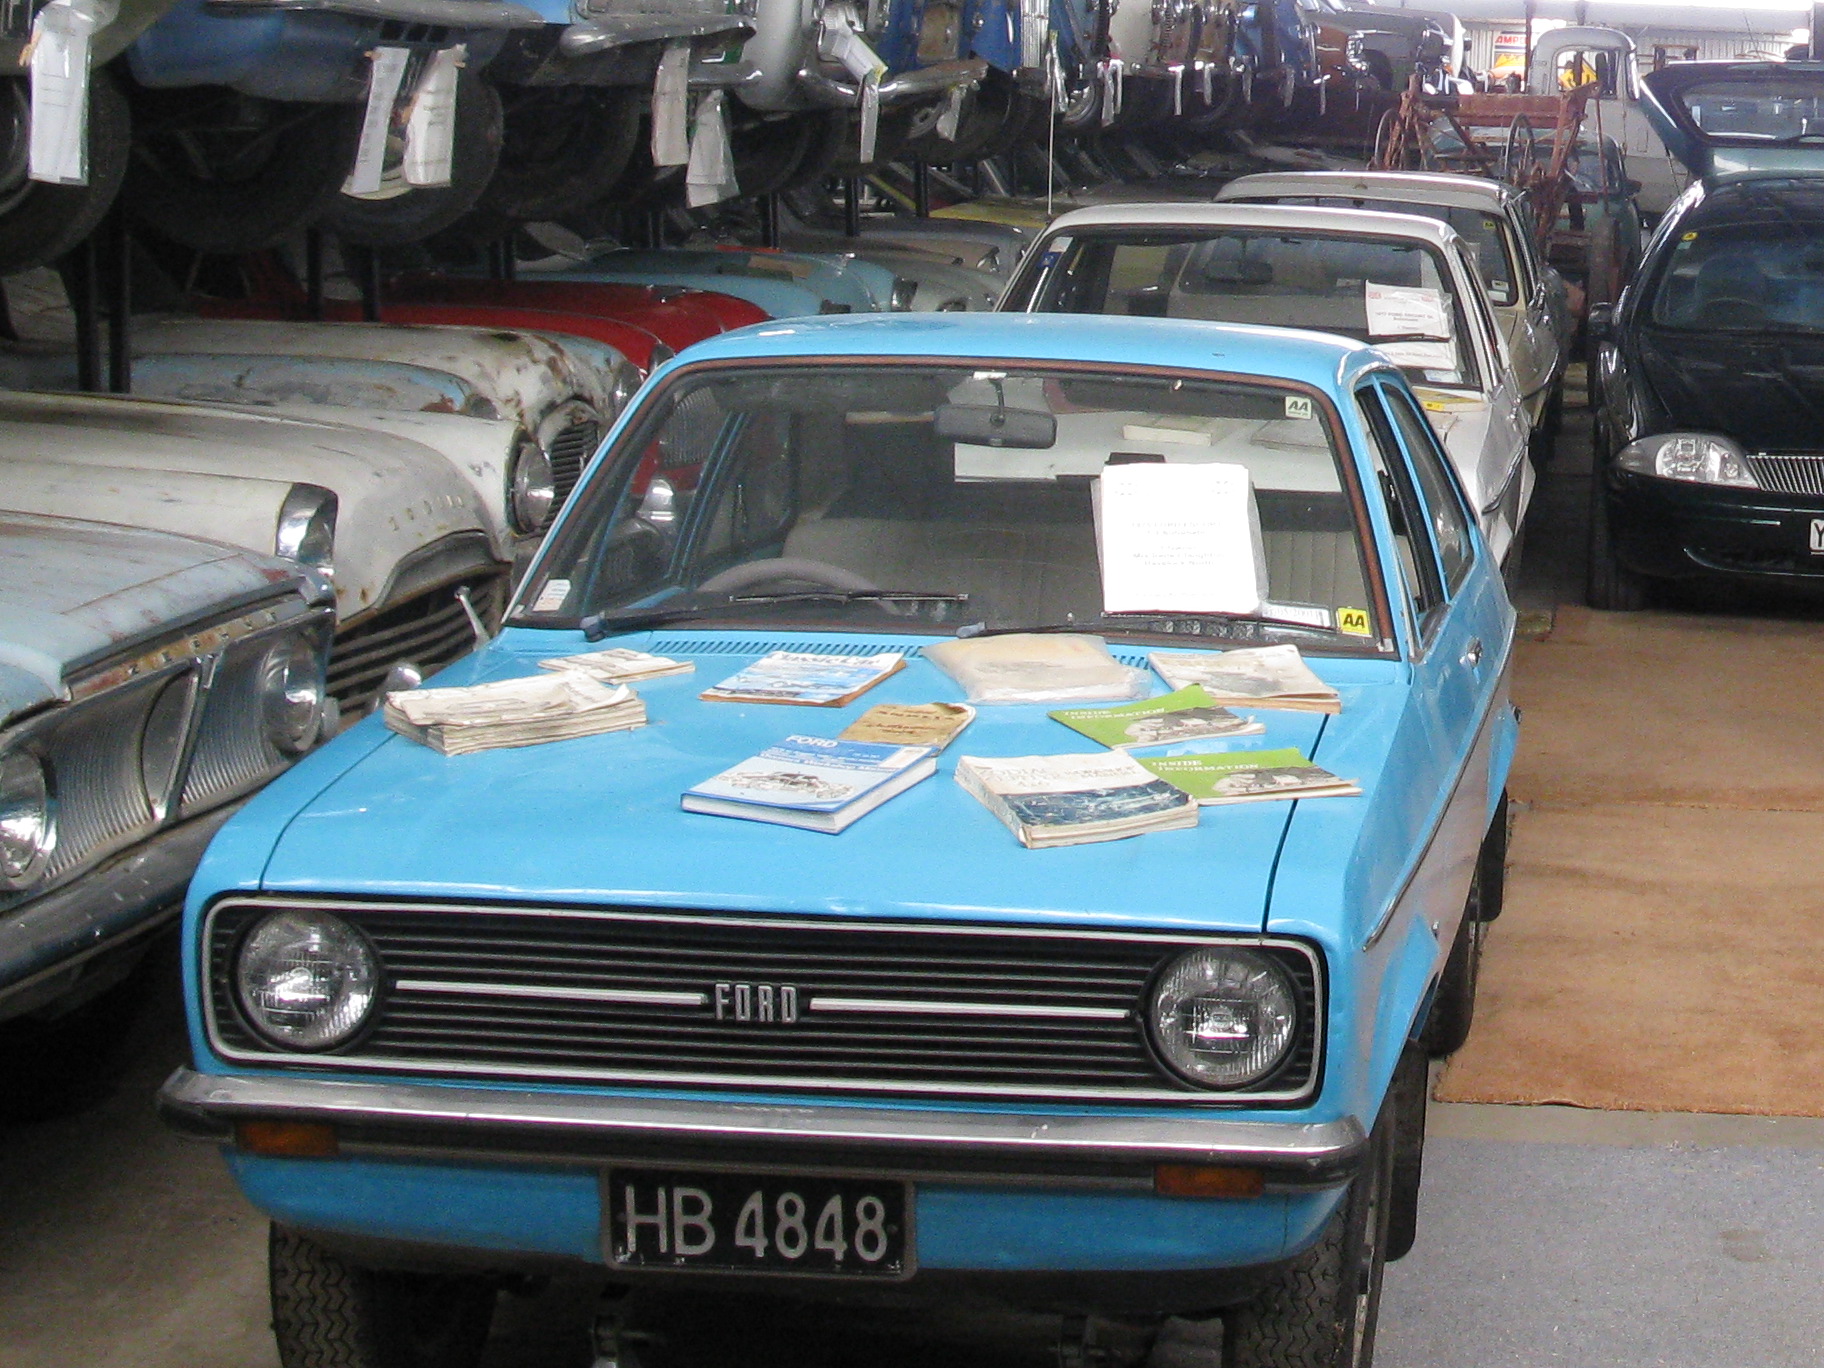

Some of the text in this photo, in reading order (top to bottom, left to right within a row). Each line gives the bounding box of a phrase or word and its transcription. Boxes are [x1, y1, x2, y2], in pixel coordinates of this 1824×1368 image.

[1288, 399, 1309, 412] AA
[1343, 613, 1365, 628] AA
[1064, 709, 1111, 717] INSIDE
[1070, 707, 1166, 720] INFORMATION
[785, 734, 839, 749] FORD
[1152, 759, 1203, 767] INSIDE
[1158, 763, 1259, 772] INFORMATION
[715, 983, 798, 1023] FORD
[625, 1185, 888, 1262] HB 4848
